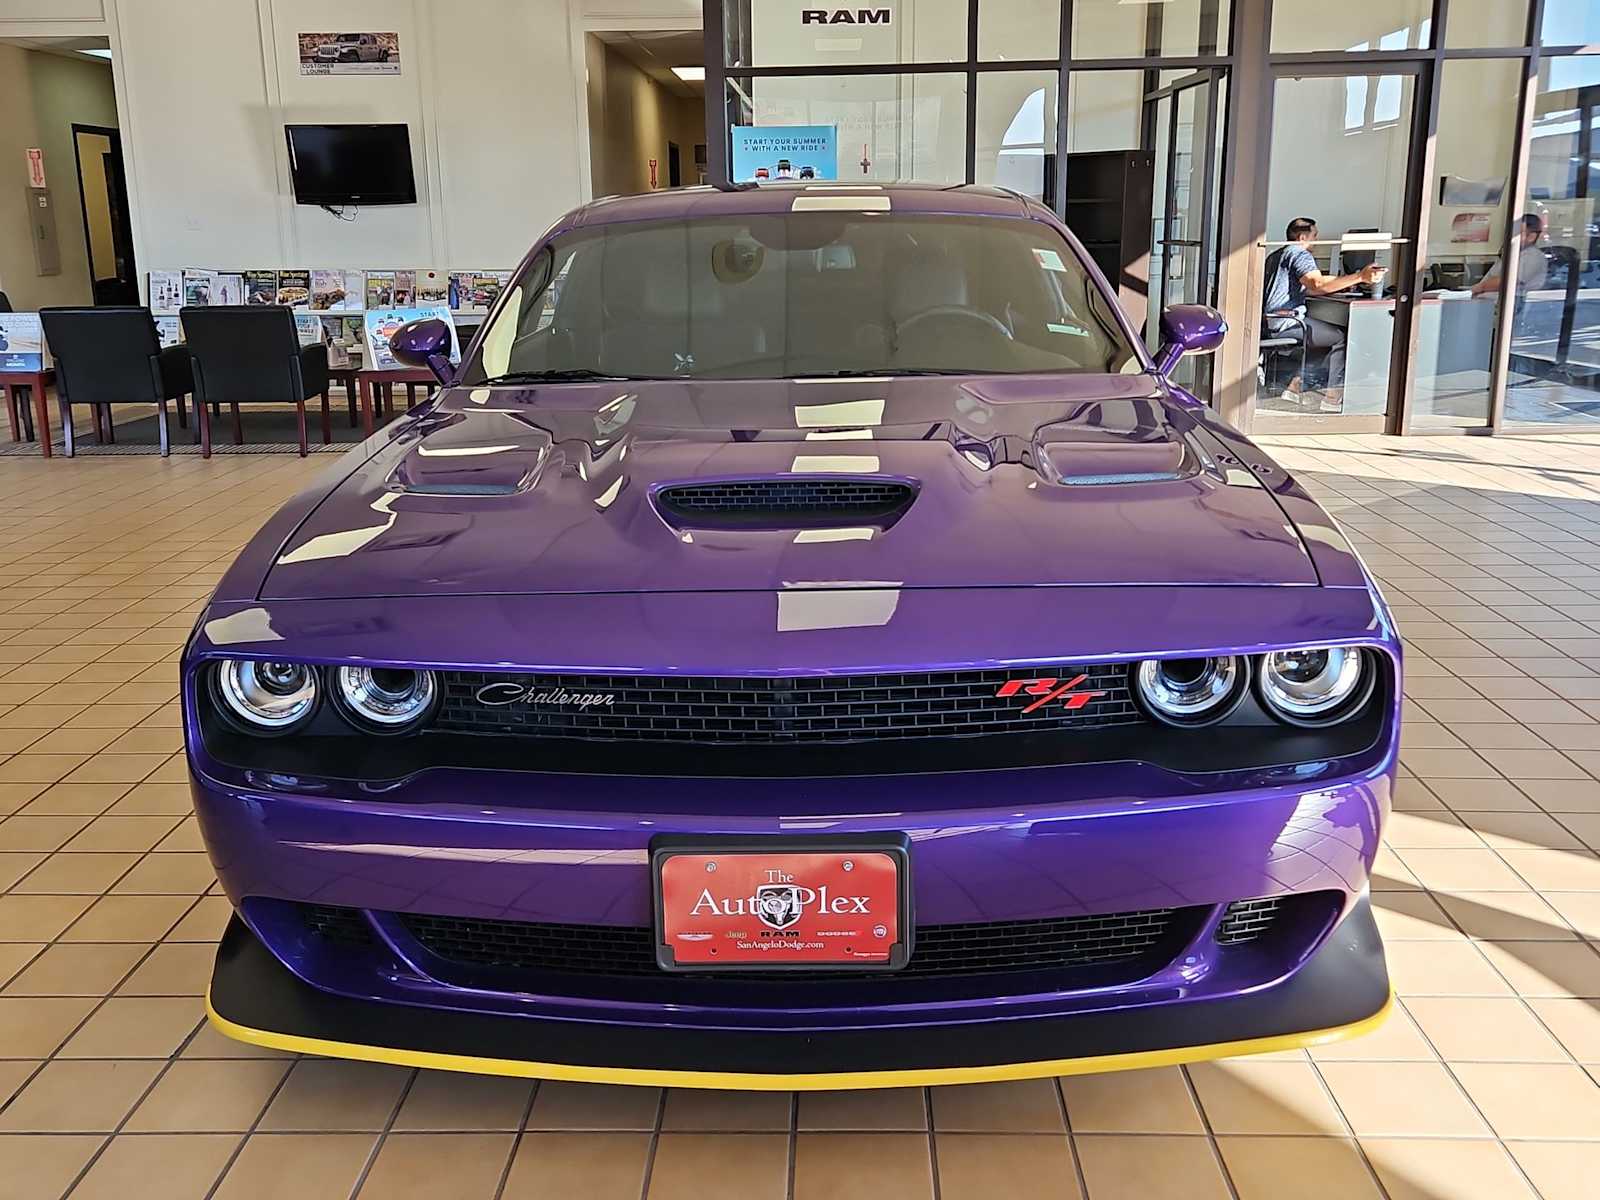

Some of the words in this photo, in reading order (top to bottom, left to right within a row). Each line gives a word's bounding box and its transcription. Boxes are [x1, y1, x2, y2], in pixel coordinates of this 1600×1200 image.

[802, 9, 890, 25] RAM
[476, 682, 616, 712] Challenger
[995, 674, 1107, 713] R/T
[764, 869, 794, 883] The
[736, 940, 825, 950] SanAngeloDodge.com
